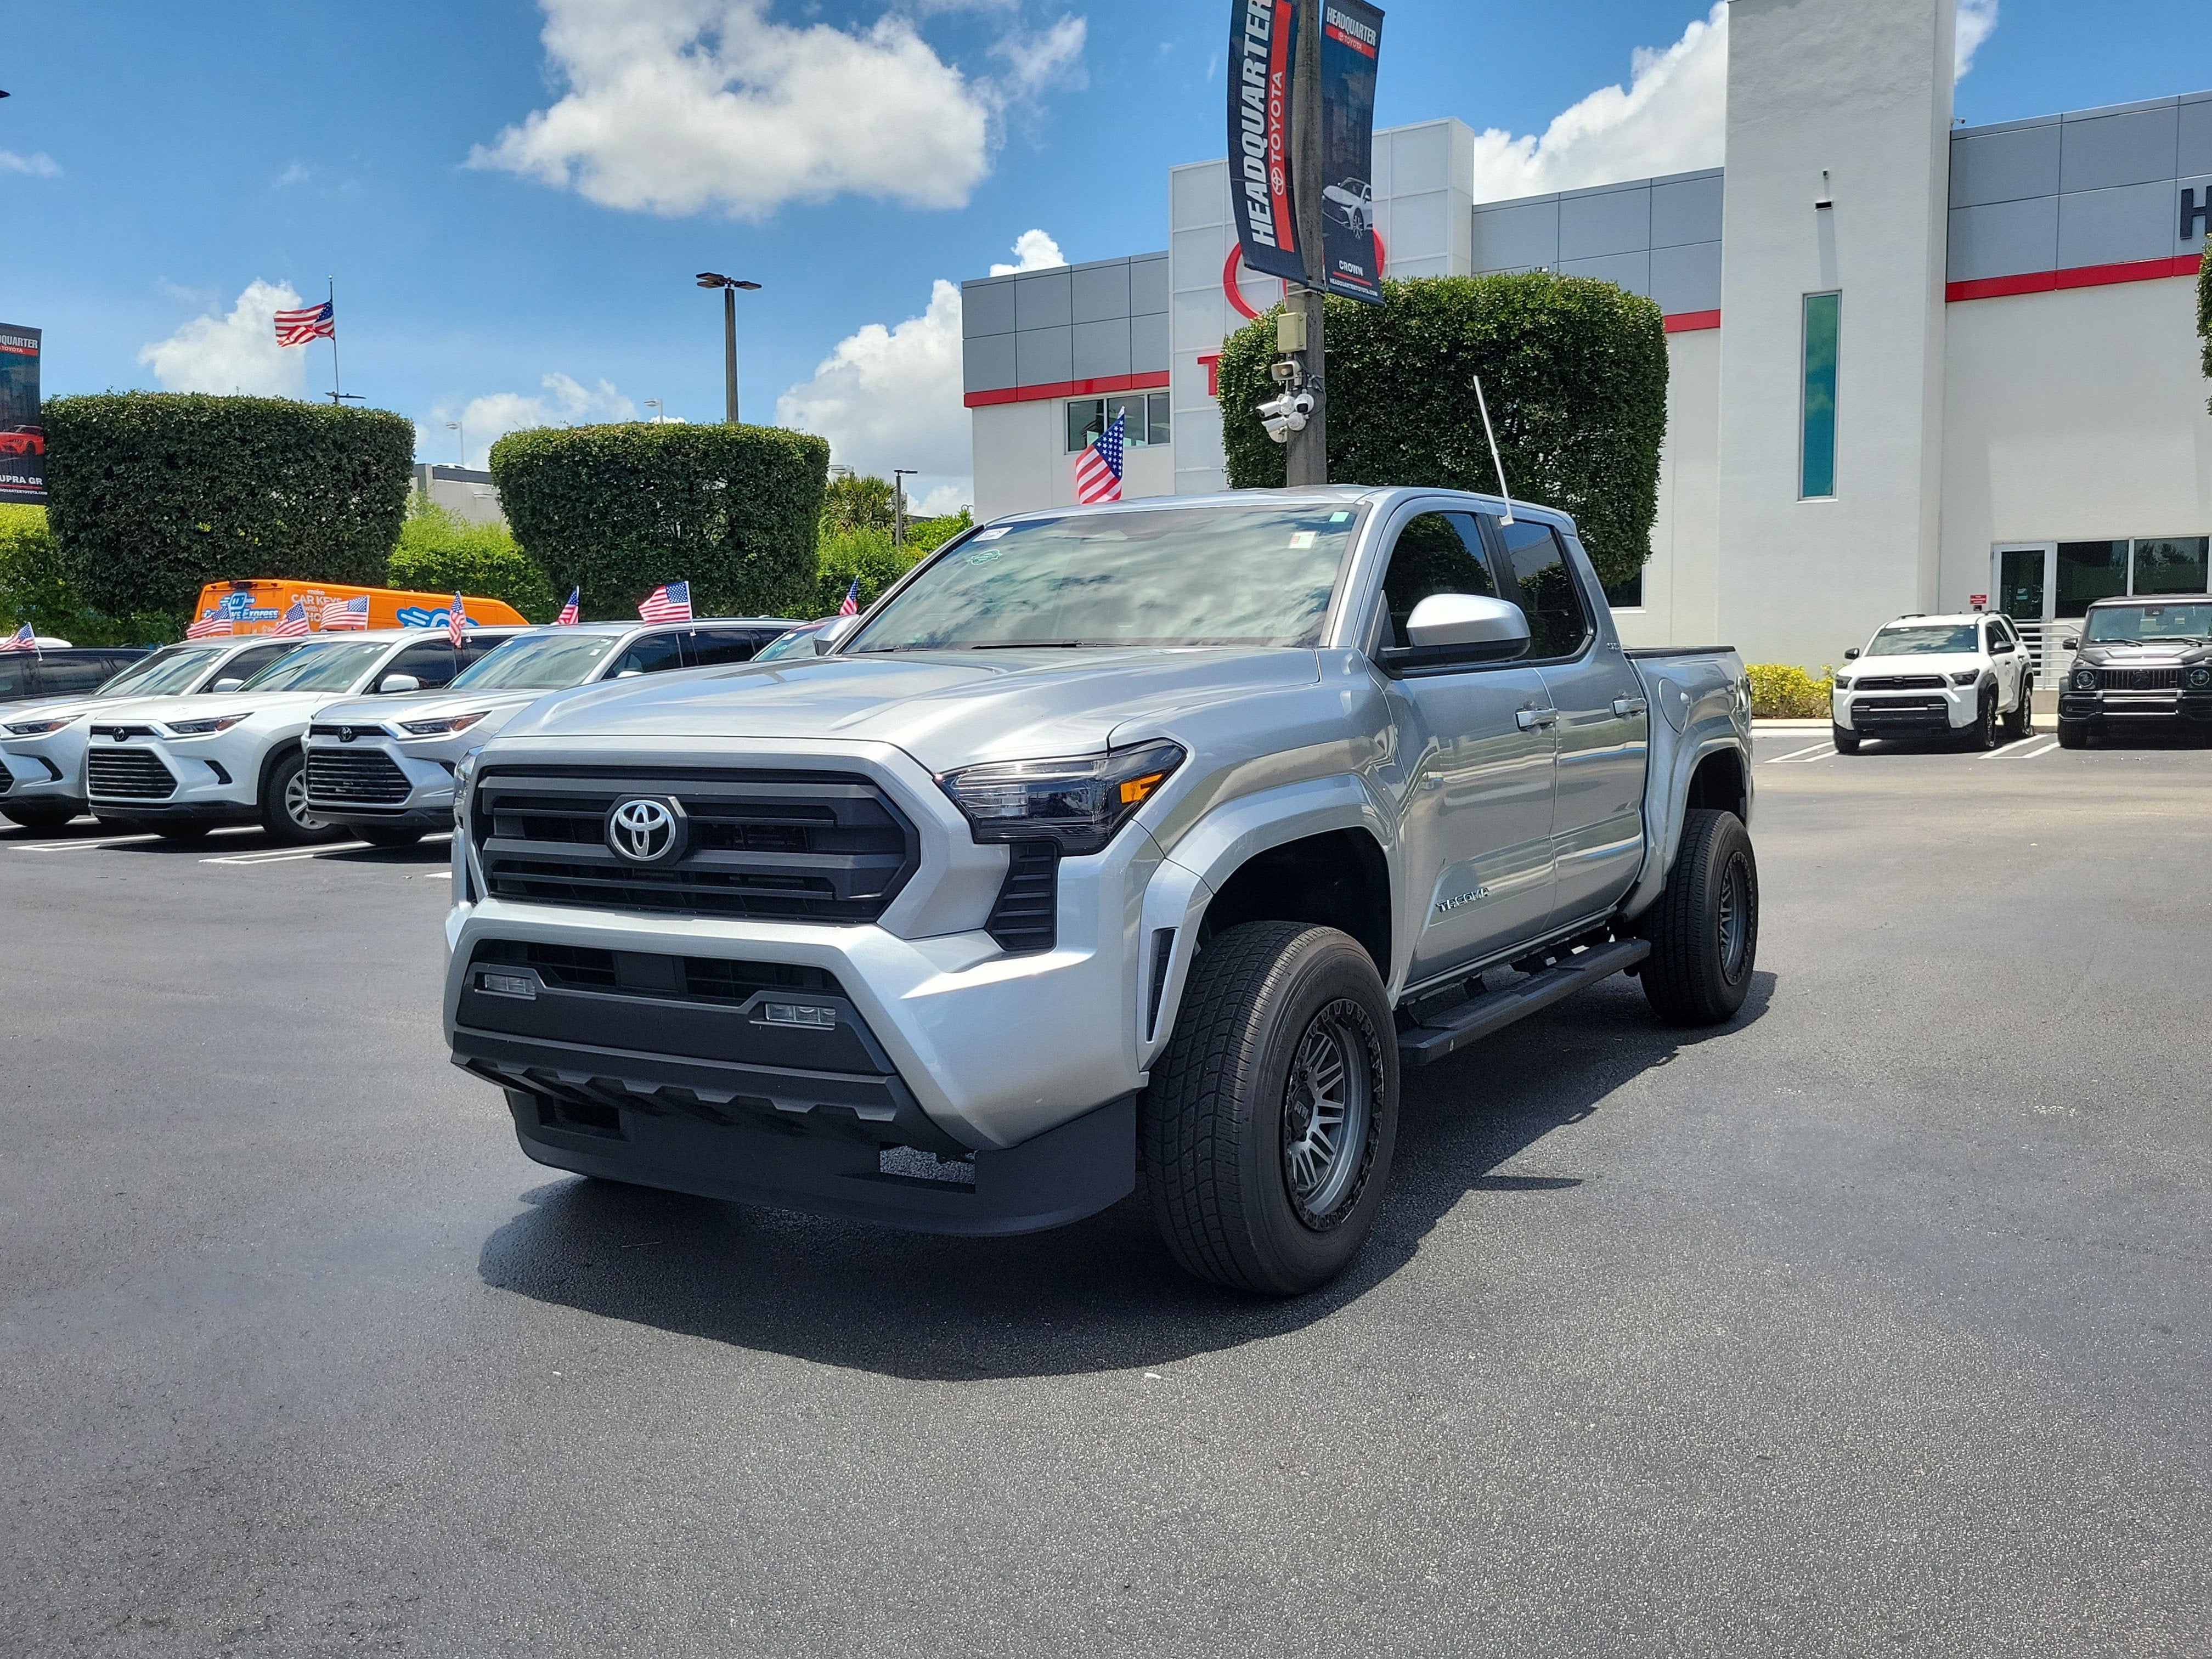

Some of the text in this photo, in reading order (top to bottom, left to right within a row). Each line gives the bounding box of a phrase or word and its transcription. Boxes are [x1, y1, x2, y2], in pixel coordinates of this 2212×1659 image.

[1327, 7, 1376, 47] HEADQUARTER
[1344, 35, 1363, 50] TOYOTA
[1241, 0, 1276, 247] HEADQUARTER
[1271, 71, 1283, 163] TOYOTA
[1339, 260, 1364, 276] CROWN
[0, 335, 38, 349] QUARTER
[29, 477, 43, 485] GR
[291, 594, 314, 605] CAR
[242, 608, 279, 622] Express
[1436, 887, 1490, 912] TACOMA
